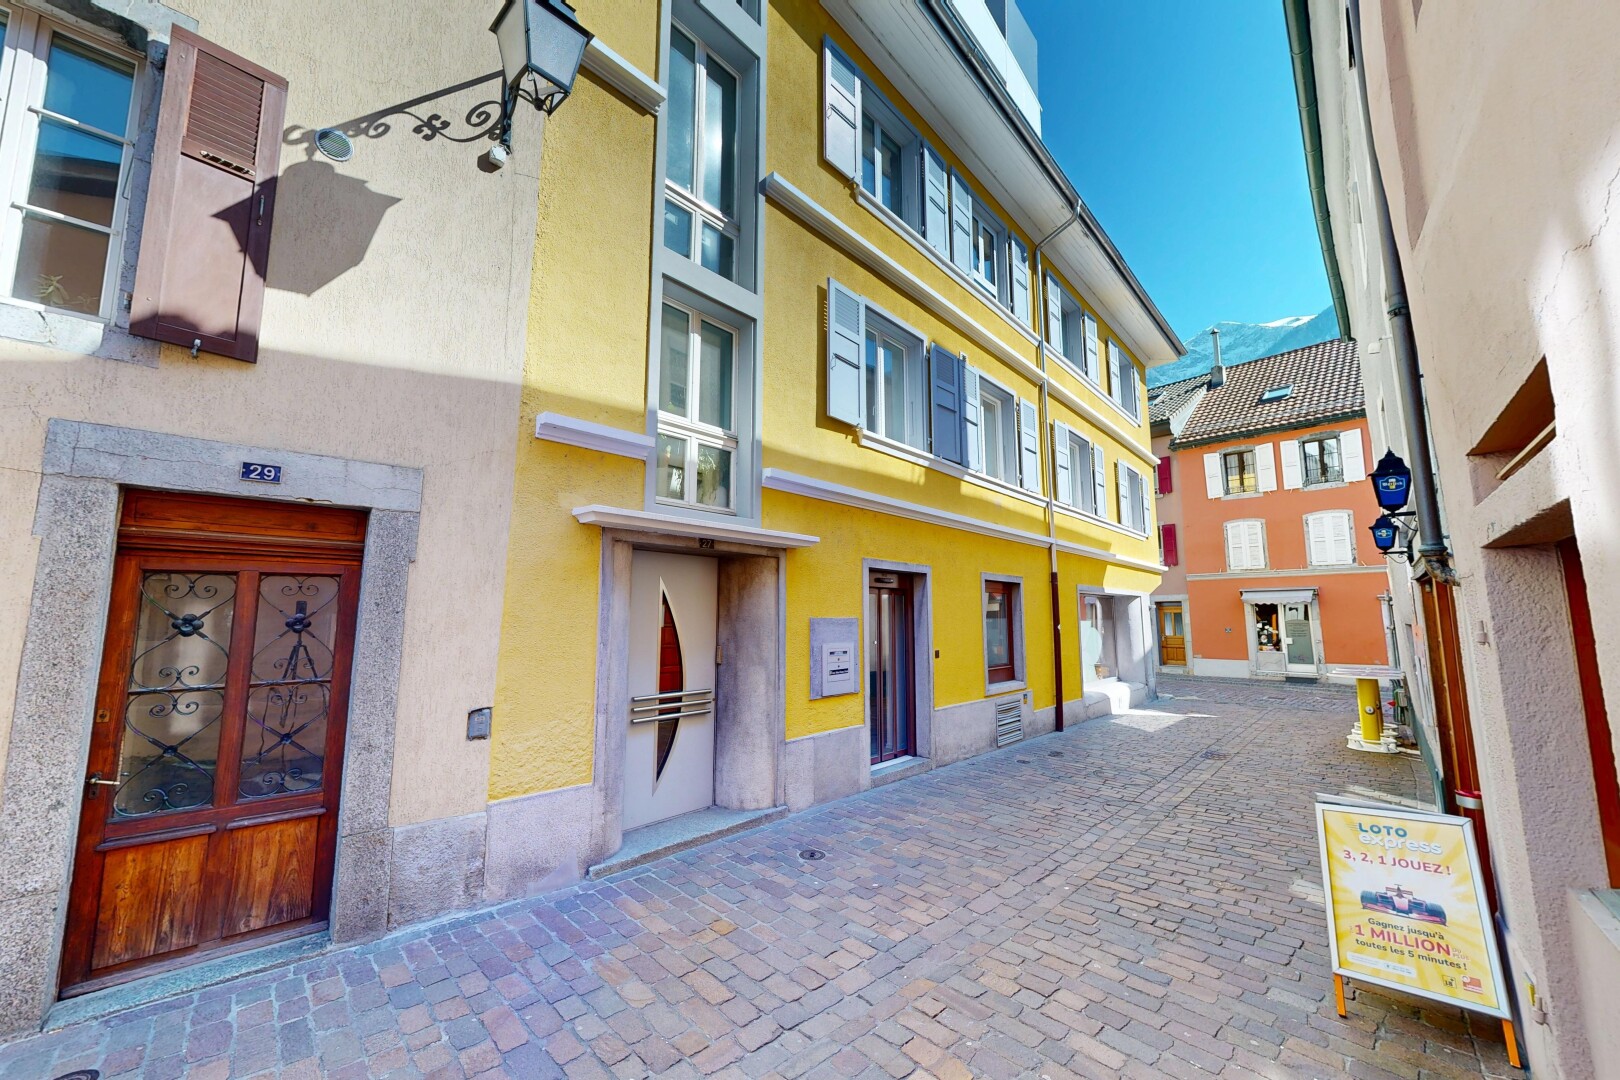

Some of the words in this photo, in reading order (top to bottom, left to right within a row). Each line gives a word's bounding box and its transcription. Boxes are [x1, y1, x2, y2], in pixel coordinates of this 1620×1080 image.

[249, 465, 275, 480] 29
[702, 539, 712, 548] 27
[1358, 822, 1407, 838] LOTO
[1358, 833, 1443, 855] express
[1378, 855, 1387, 865] 1
[1391, 857, 1443, 875] JOUEZ
[1367, 917, 1405, 932] Gagnez
[1407, 925, 1445, 940] jusqu'à
[1354, 924, 1365, 936] 1
[1370, 927, 1451, 957] MILLION
[1355, 938, 1387, 952] toutes
[1390, 945, 1405, 956] les
[1408, 949, 1415, 958] 5
[1418, 953, 1462, 970] minutes
